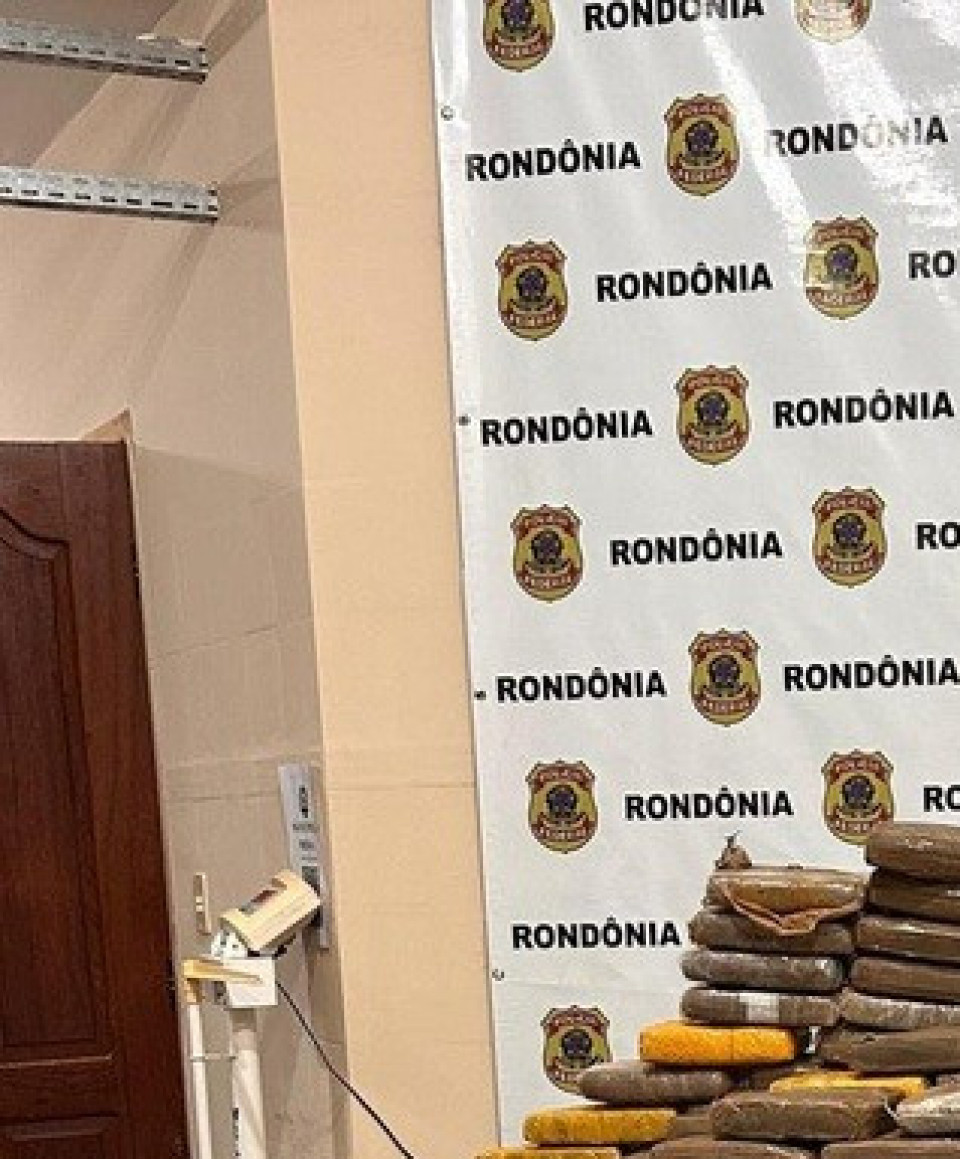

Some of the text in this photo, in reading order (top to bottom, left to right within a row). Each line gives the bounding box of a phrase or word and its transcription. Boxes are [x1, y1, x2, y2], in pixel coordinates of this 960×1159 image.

[465, 139, 641, 182] RONDÔNIA
[597, 262, 773, 302] RONDÔNIA
[480, 409, 653, 446] RONDÔNIA
[773, 389, 955, 429] RONDÔNIA
[610, 528, 782, 566] RONDÔNIA
[496, 667, 667, 703] RONDÔNIA
[784, 655, 960, 692] RONDÔNIA
[625, 787, 795, 821] RONDÔNIA
[512, 916, 681, 949] RONDÔNIA
